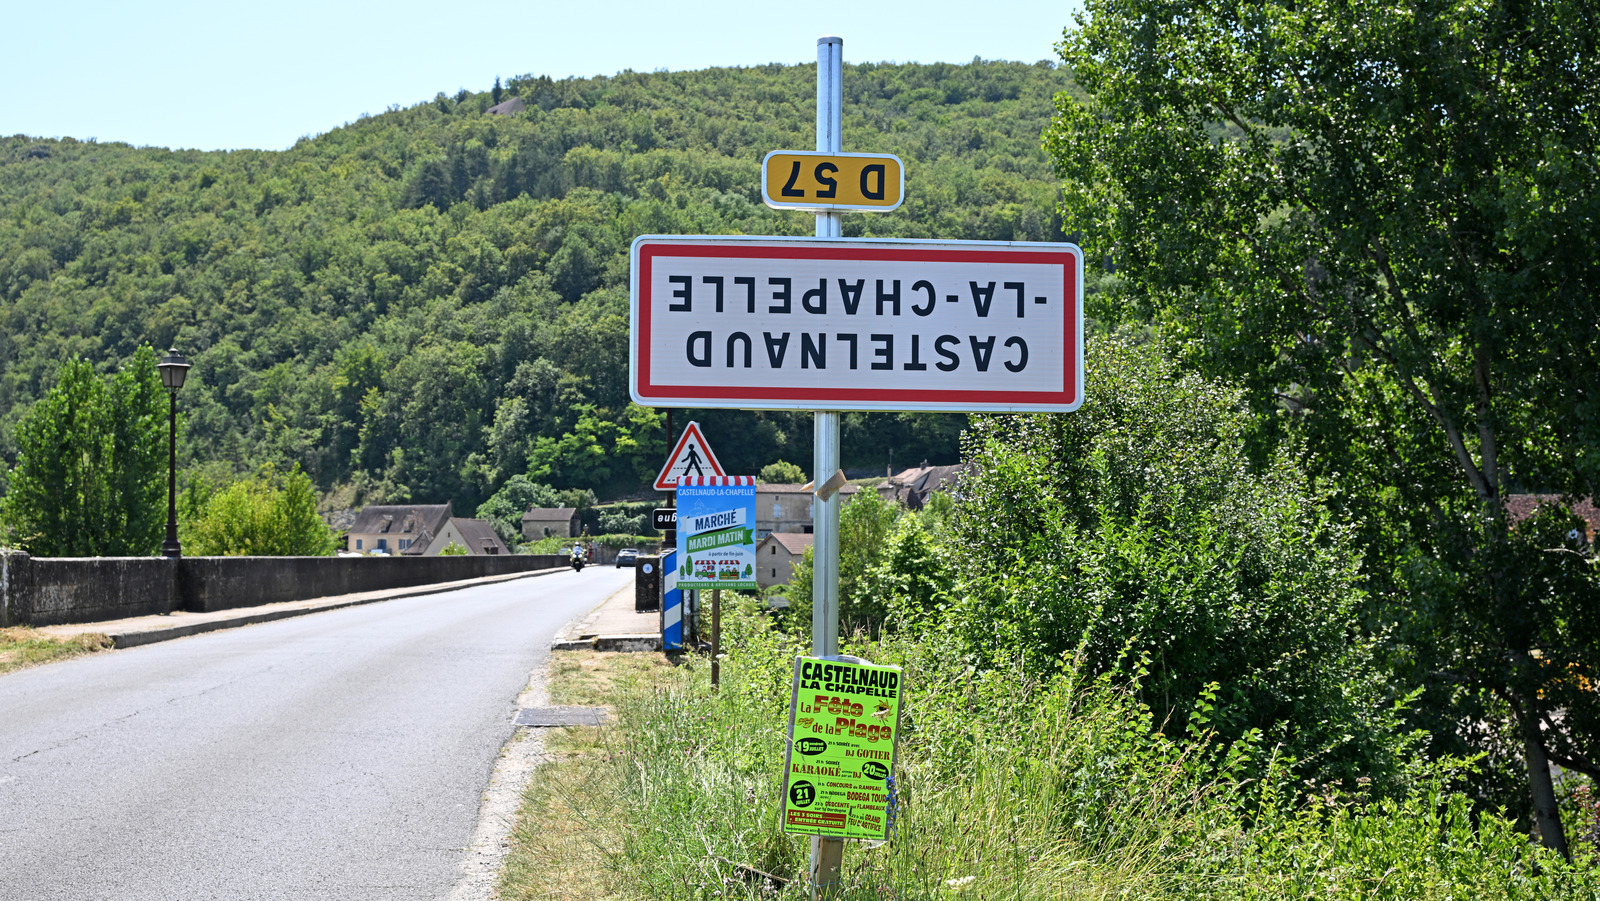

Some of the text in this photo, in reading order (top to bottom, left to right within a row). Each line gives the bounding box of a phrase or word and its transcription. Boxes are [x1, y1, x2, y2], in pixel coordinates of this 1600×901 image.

[781, 161, 886, 200] D 57
[686, 330, 1029, 373] CASTELNAUD
[695, 511, 737, 531] MARCHÉ
[689, 530, 744, 551] MARDI MATIN
[802, 662, 898, 689] CASTELNAUD
[801, 680, 897, 699] LA CHAPELLE
[800, 695, 864, 717] La Fête
[812, 717, 892, 743] de la Plage
[796, 741, 810, 752] 19
[845, 748, 890, 761] DJ GOTIER
[792, 763, 841, 777] KARAOKÉ
[853, 771, 862, 779] DJ
[863, 763, 876, 775] 20
[826, 781, 853, 790] CONCOURS
[796, 788, 809, 799] 21
[846, 791, 870, 802] BODEGA
[825, 801, 850, 809] DESCENTE
[856, 803, 886, 812] FLAMBEAUX
[848, 818, 857, 826] FEU
[865, 814, 881, 824] GRAND
